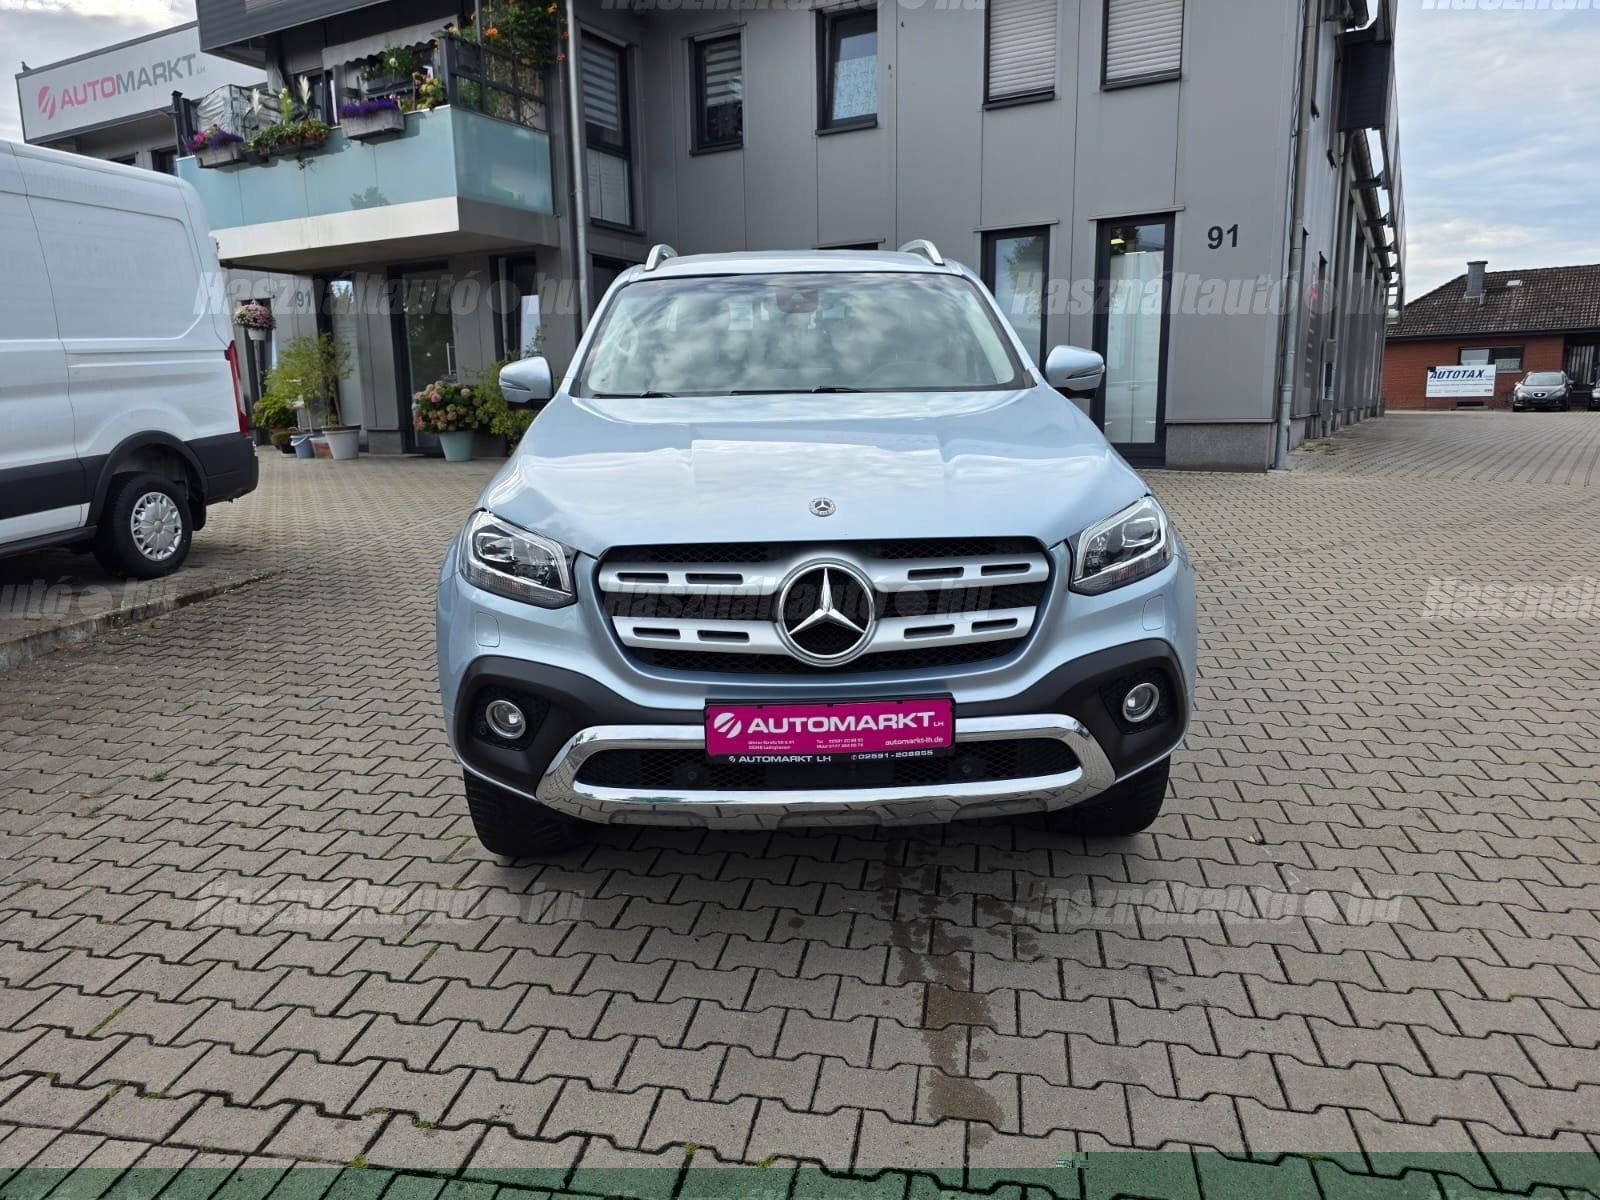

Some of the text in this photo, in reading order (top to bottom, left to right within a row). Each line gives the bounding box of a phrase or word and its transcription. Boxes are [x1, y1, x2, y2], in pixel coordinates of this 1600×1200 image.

[60, 53, 197, 109] AUTOMARKT
[1208, 224, 1238, 249] 91
[1430, 369, 1485, 379] AUTOTAX
[747, 711, 935, 733] AUTOMARKT
[738, 755, 831, 763] AUTOMARKT LH
